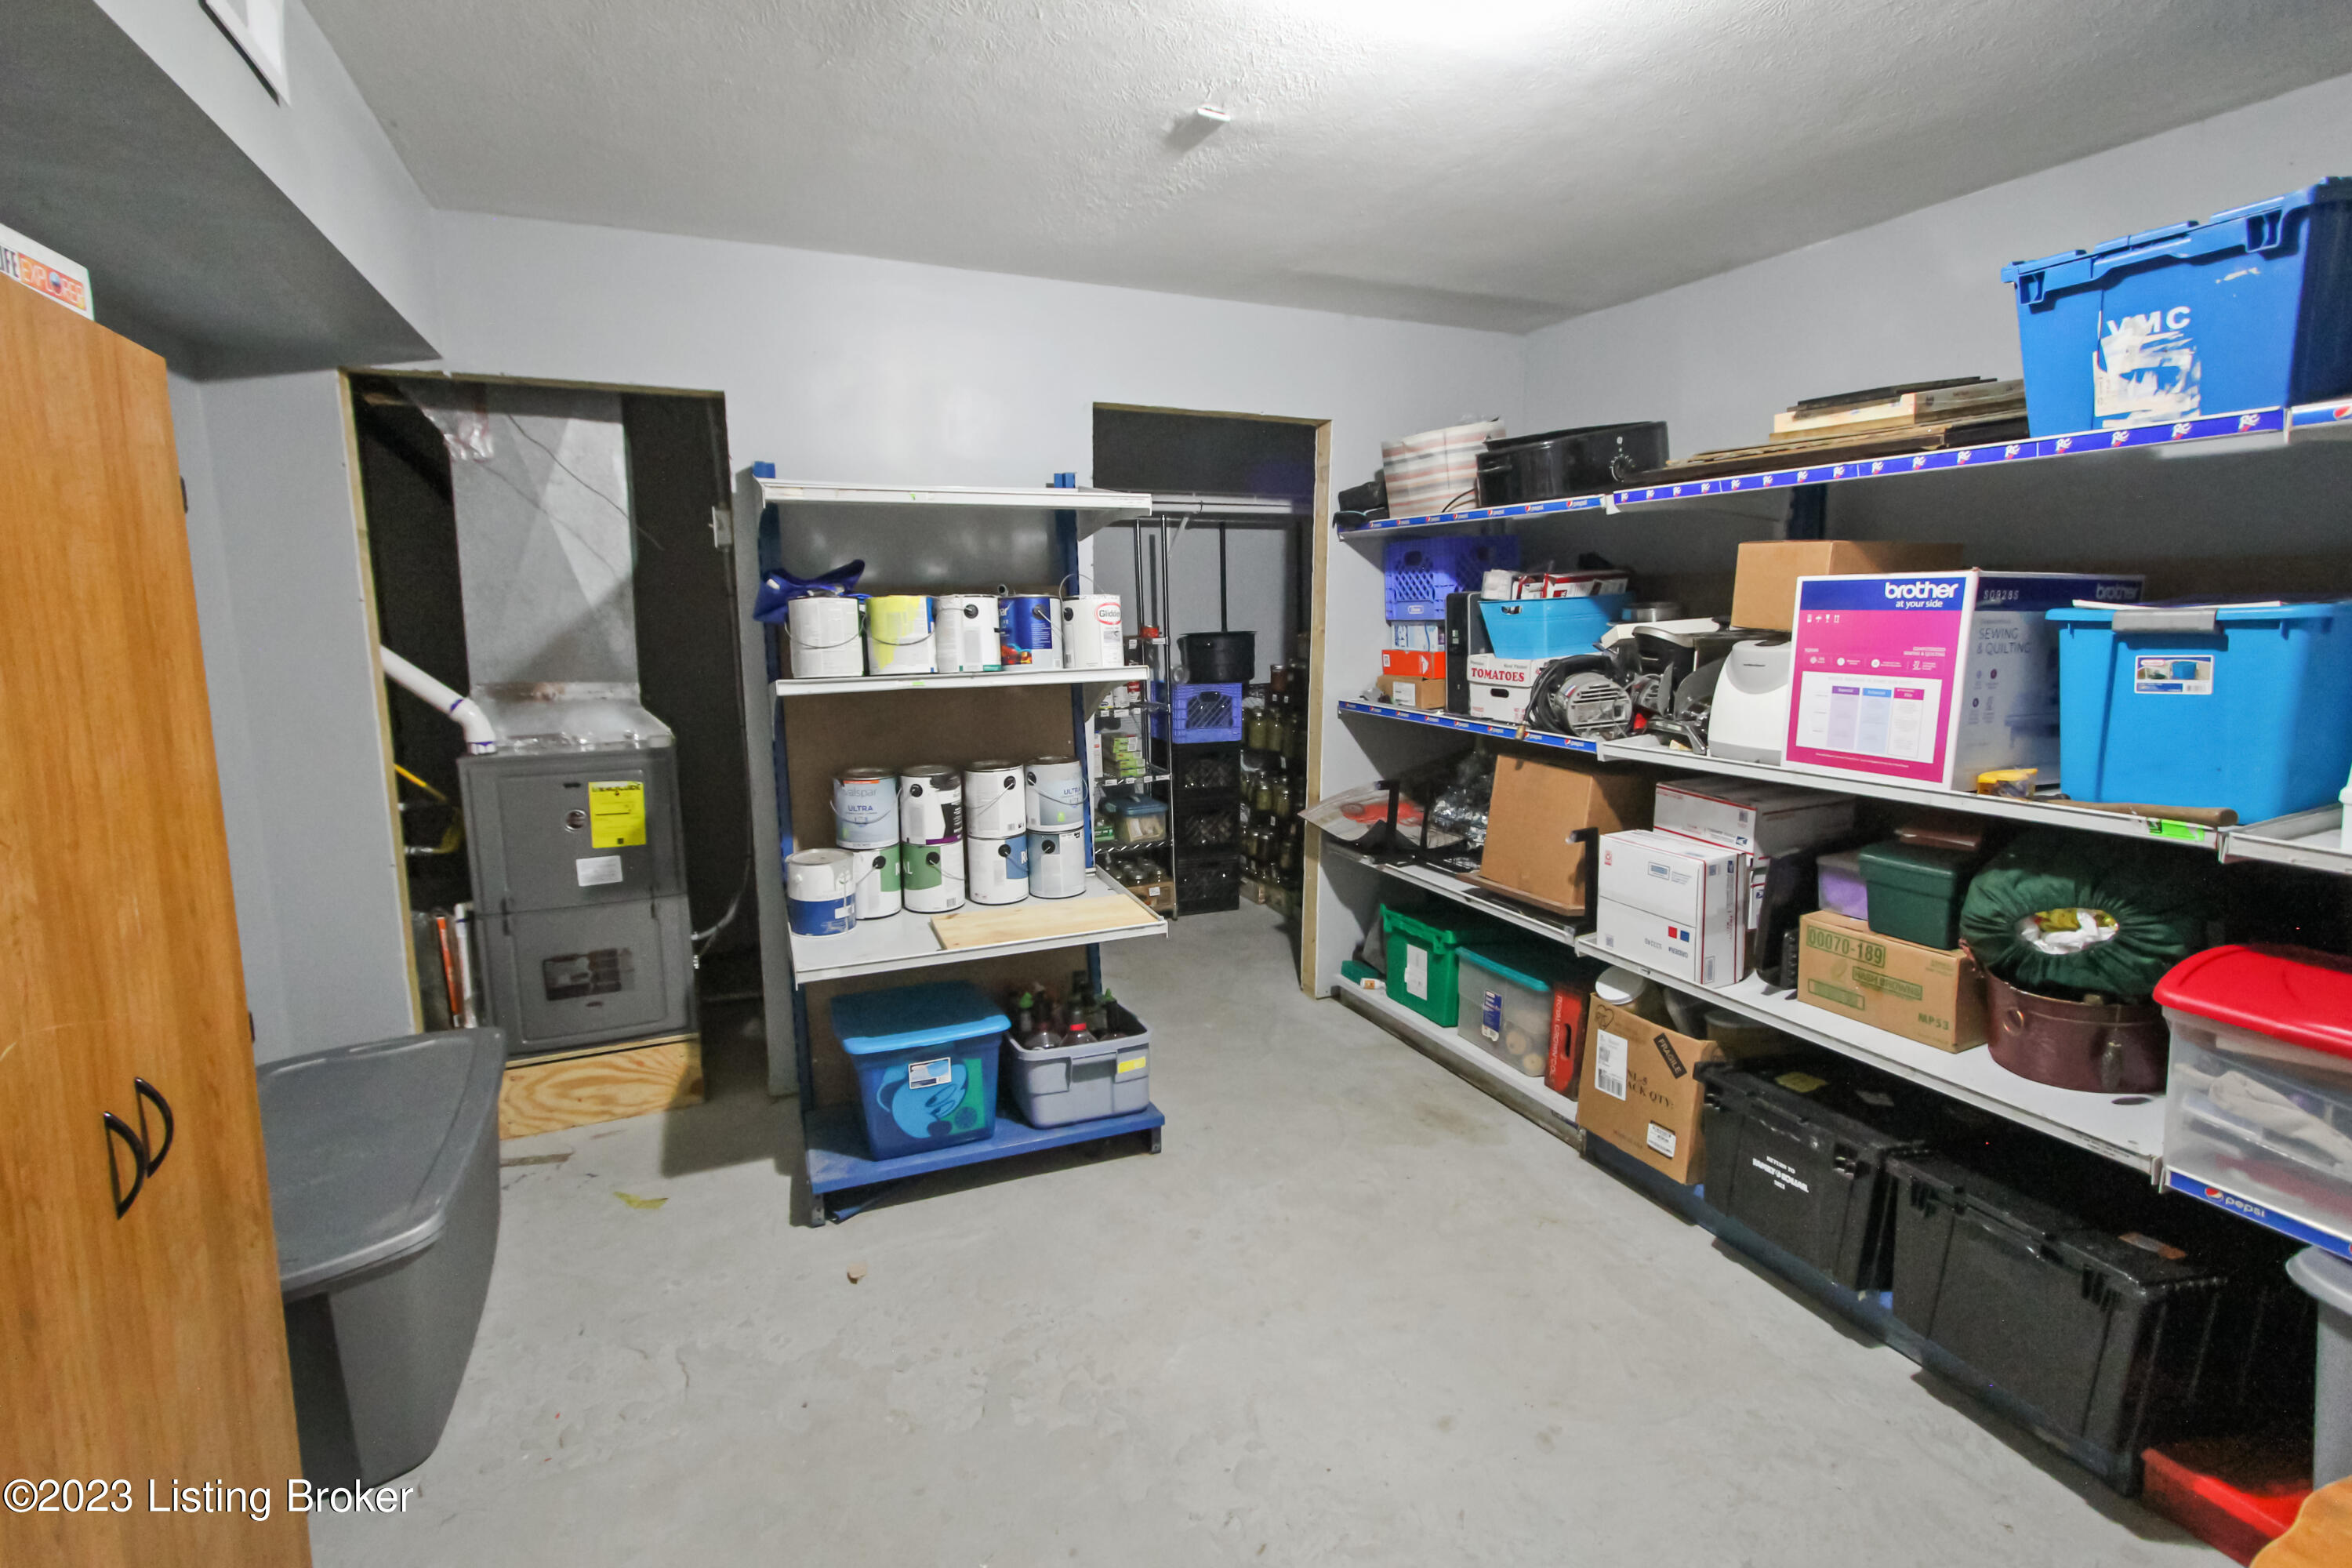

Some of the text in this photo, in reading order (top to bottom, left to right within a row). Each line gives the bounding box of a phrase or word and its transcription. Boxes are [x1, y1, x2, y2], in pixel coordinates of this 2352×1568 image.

[0, 245, 20, 278] IFE
[1957, 451, 1972, 464] RC
[2005, 444, 2020, 458] RC
[2056, 437, 2072, 452] RC
[2111, 430, 2130, 445] RC
[2172, 422, 2193, 439] RC
[2238, 413, 2261, 430] RC
[1884, 581, 1959, 599] brother
[2096, 583, 2139, 600] brother
[1905, 601, 1926, 609] your
[1926, 599, 1944, 608] side
[1979, 627, 2018, 640] SEWING
[1976, 641, 2032, 655] & QUILTING
[1471, 667, 1525, 682] TOMATOES
[1808, 928, 1882, 965] 00070-189
[1918, 1012, 1950, 1030] MP53
[1657, 1037, 1682, 1074] FRAGILE
[1627, 1081, 1646, 1097] ACK
[2225, 1196, 2265, 1218] pepsi
